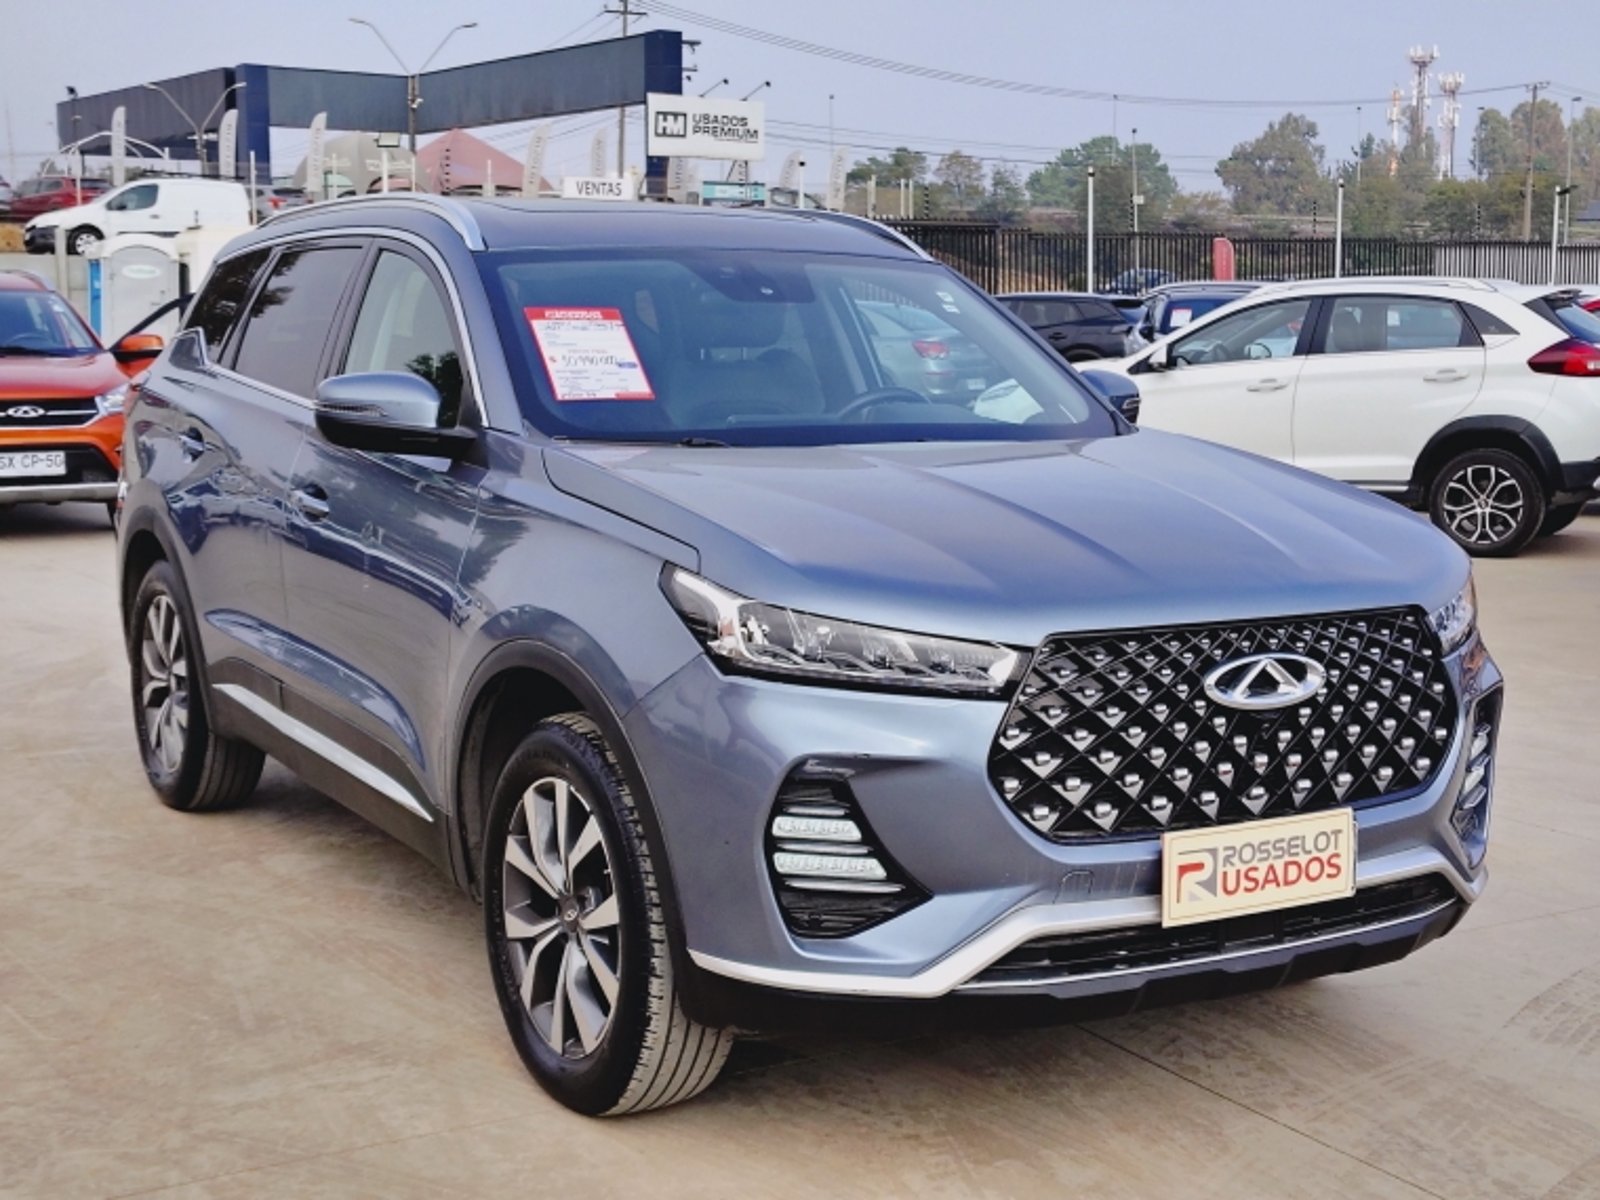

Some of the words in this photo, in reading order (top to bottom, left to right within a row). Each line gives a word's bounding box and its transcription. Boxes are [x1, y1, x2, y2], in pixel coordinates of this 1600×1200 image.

[692, 113, 748, 127] USADOS
[692, 125, 759, 139] PREMIUM
[576, 181, 622, 196] VENTAS
[1222, 829, 1343, 868] ROSSELOT
[1222, 853, 1342, 896] USADOS
